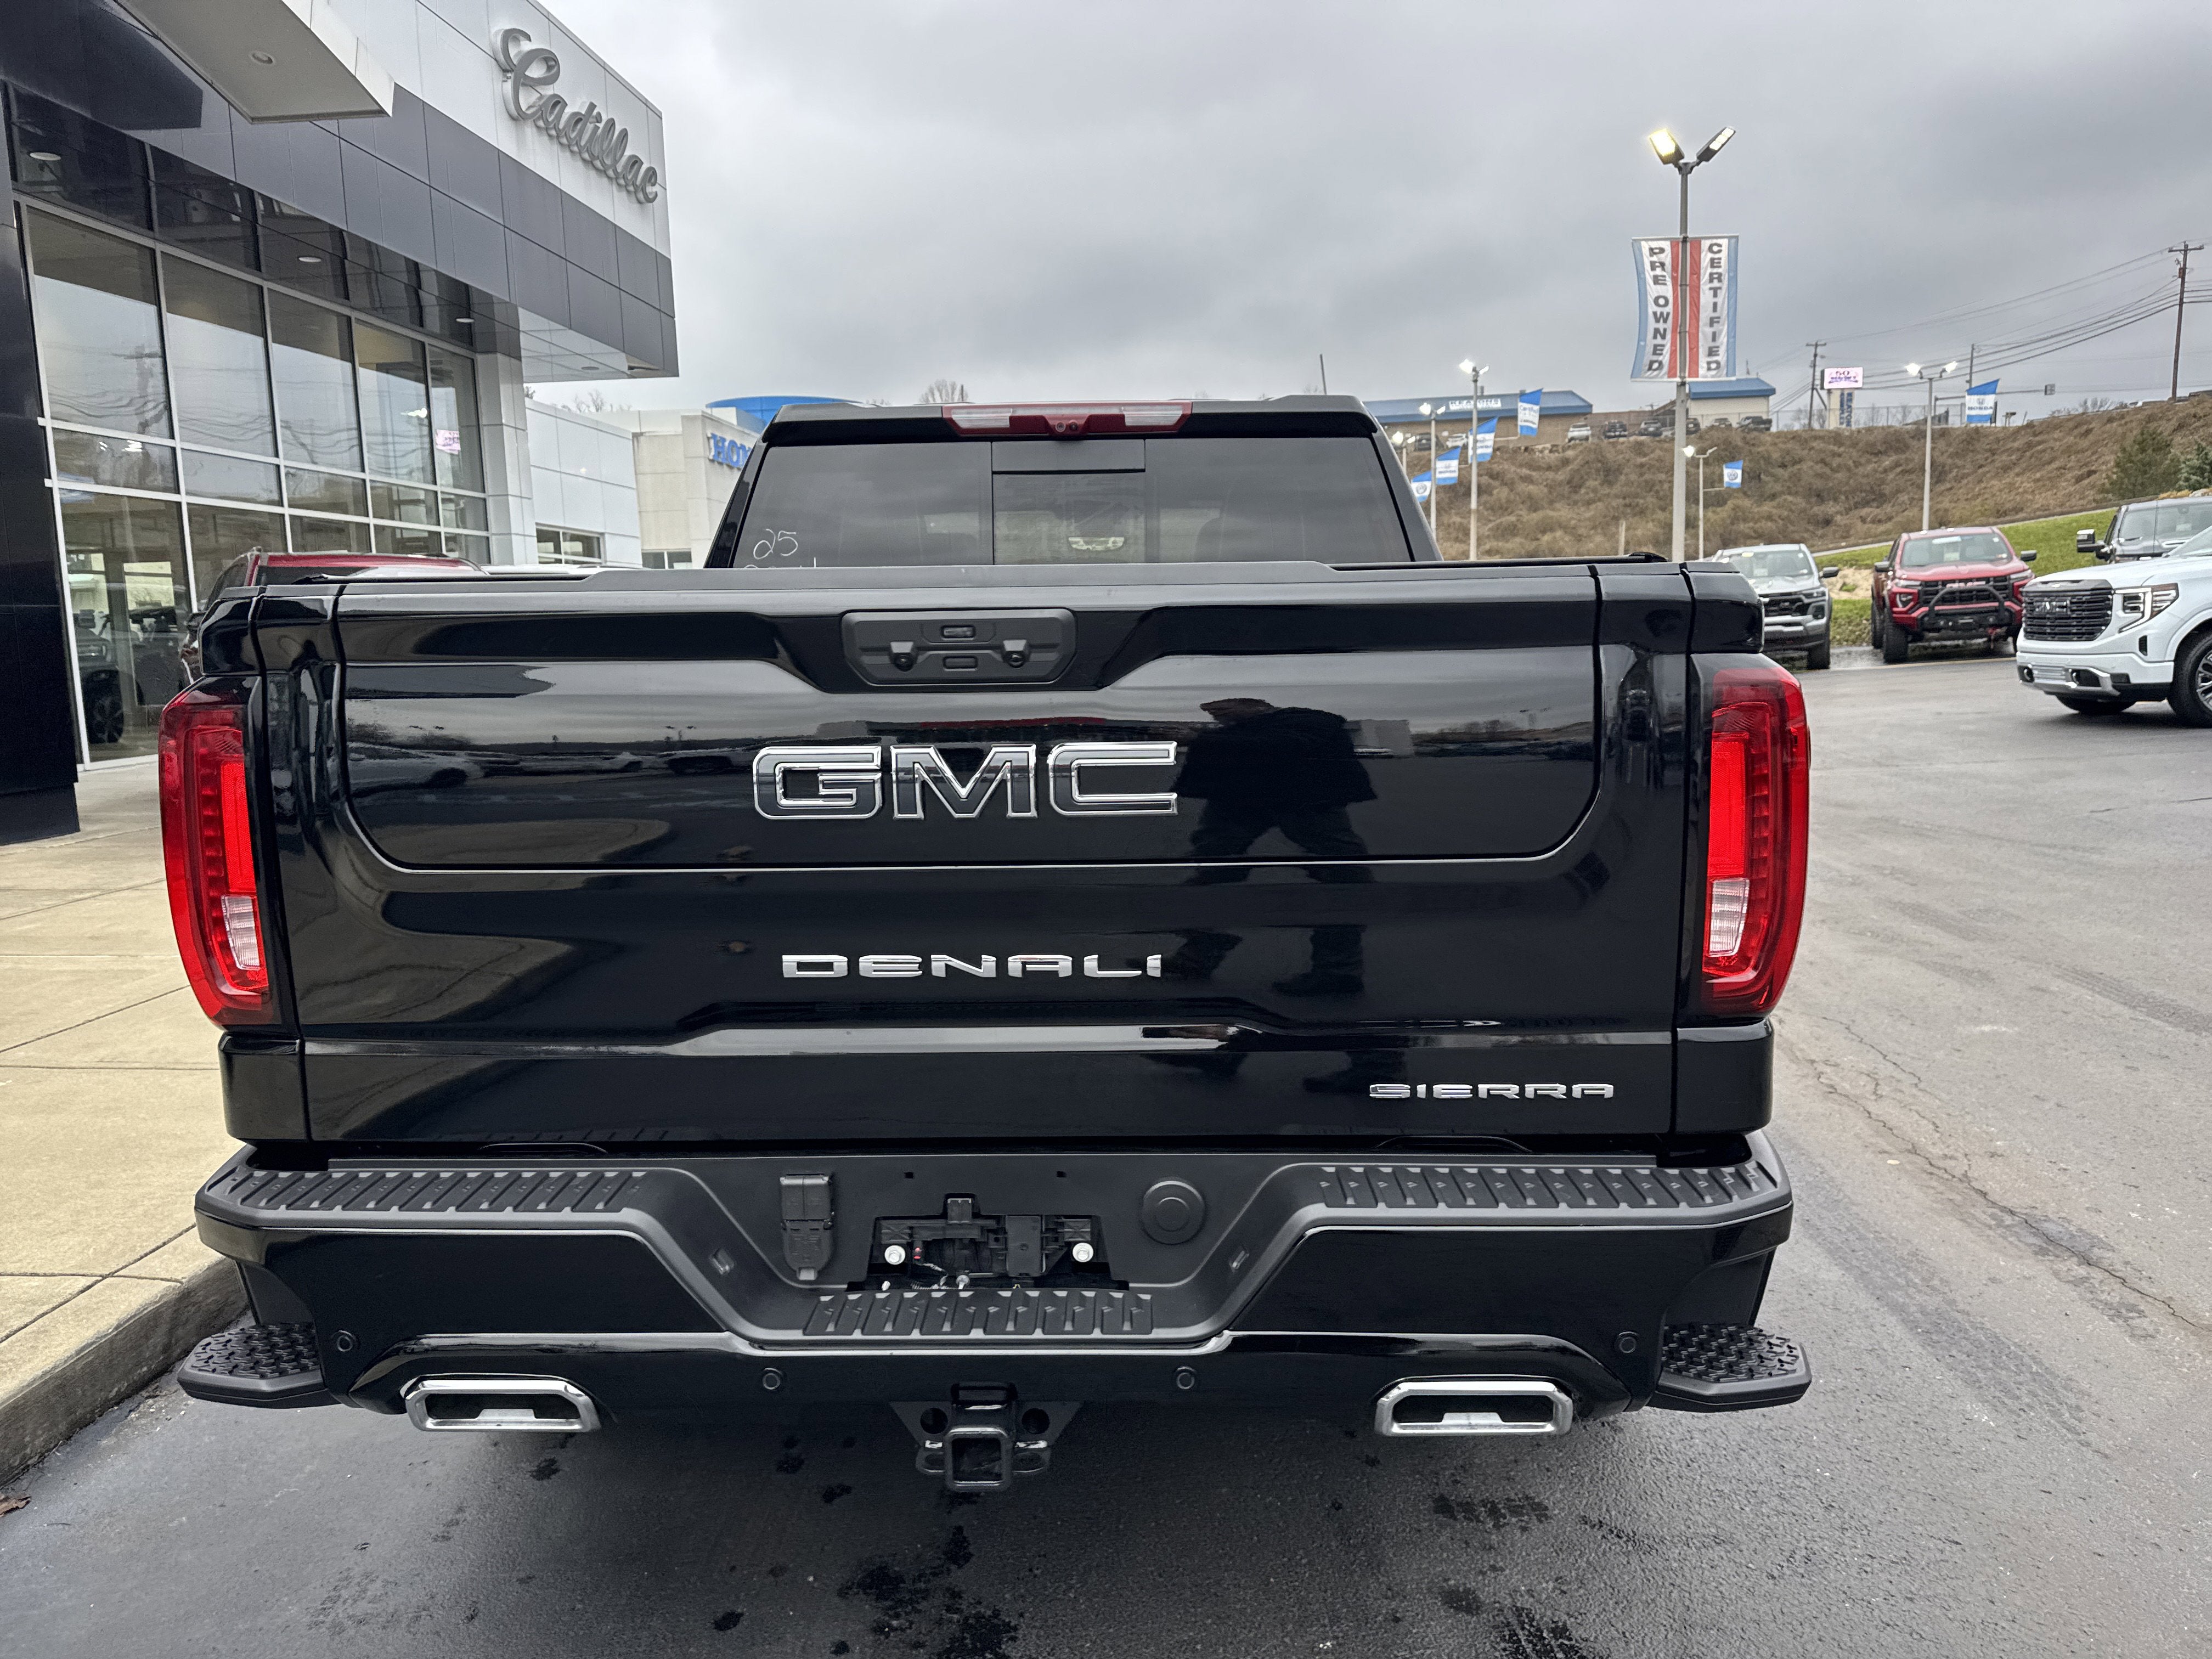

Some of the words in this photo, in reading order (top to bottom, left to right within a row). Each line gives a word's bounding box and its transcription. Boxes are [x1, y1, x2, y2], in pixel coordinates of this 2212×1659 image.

[497, 27, 658, 204] Cadillac
[1649, 247, 1667, 285] PRE
[1647, 295, 1670, 371] OWNED
[1706, 242, 1723, 371] CERTIFIED
[753, 528, 798, 560] 25
[752, 741, 1178, 820] GMC
[782, 954, 1162, 978] DENALI
[1369, 1084, 1614, 1098] SIERRA
